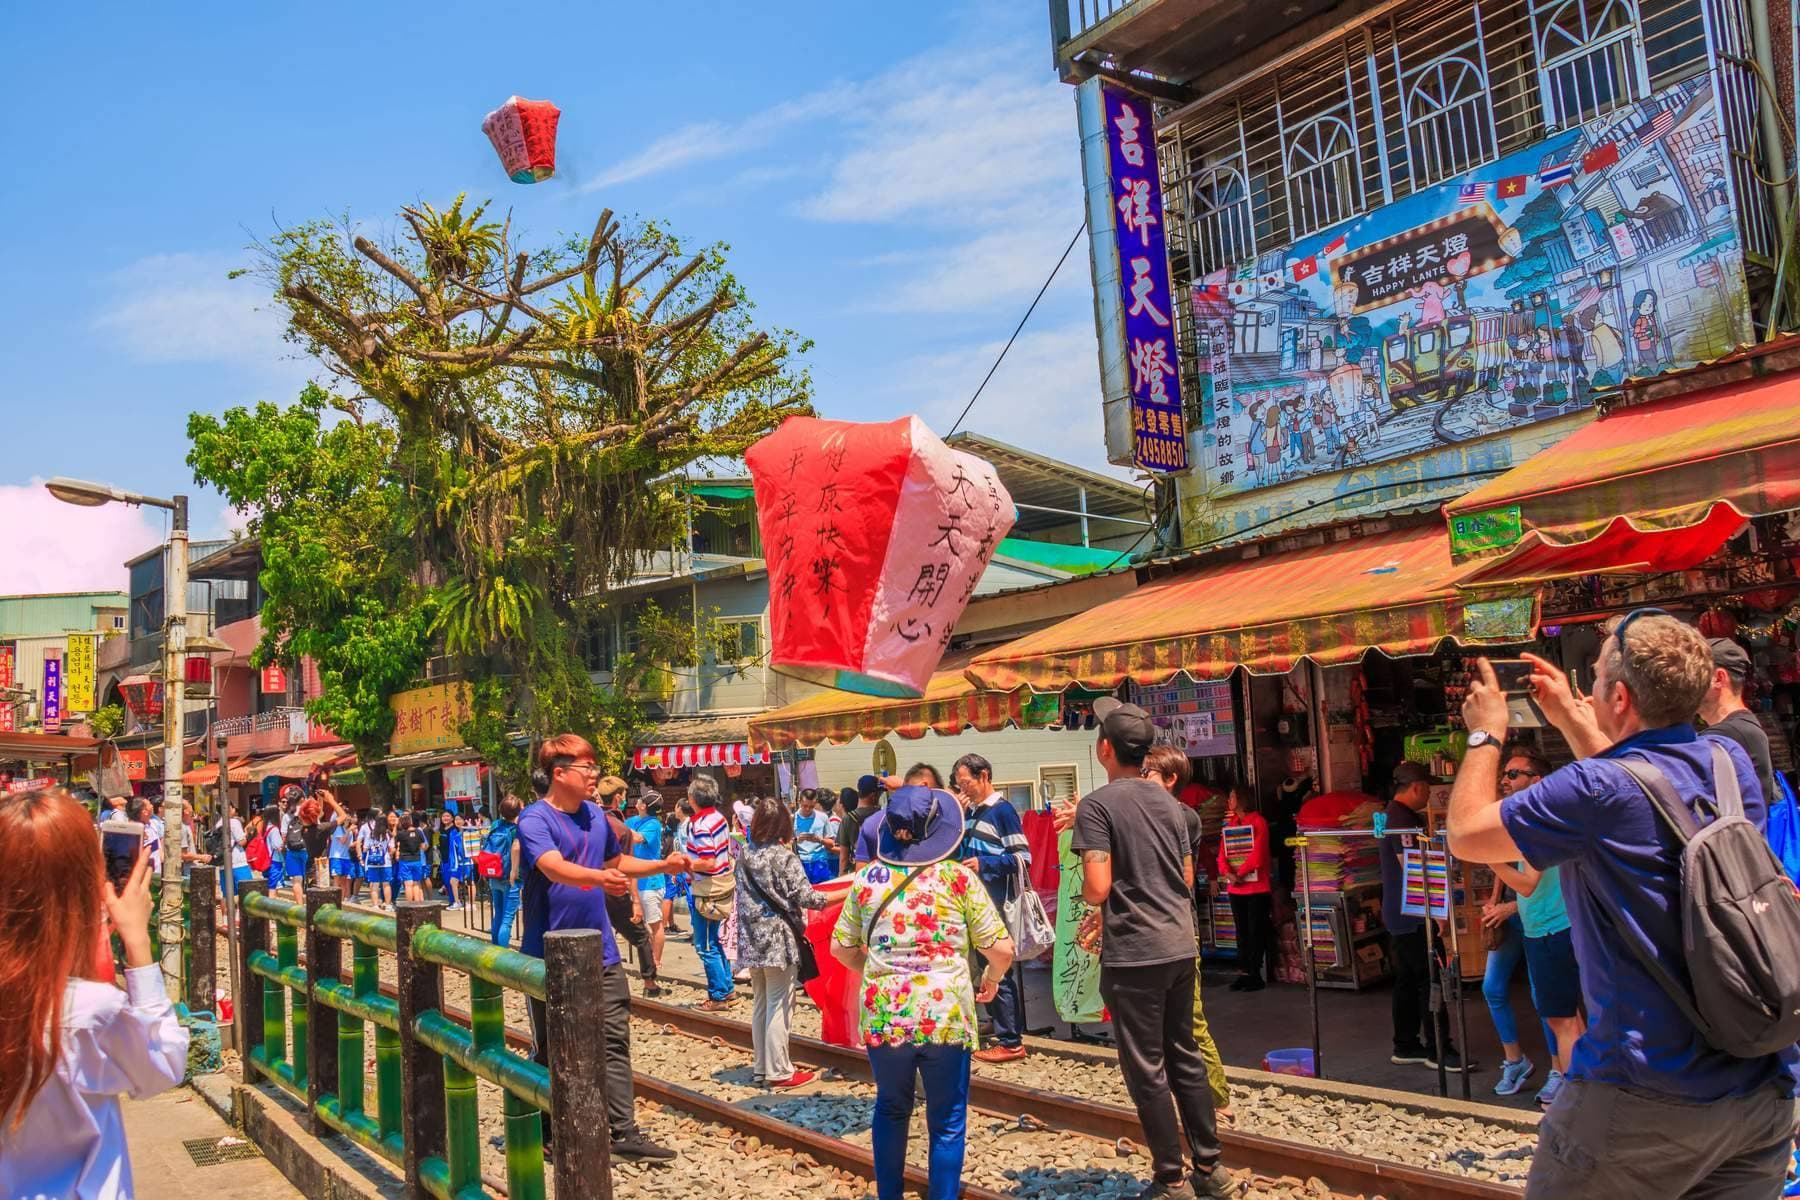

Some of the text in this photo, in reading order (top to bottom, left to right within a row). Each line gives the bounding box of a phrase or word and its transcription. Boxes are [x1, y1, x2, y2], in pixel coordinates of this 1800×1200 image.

[1114, 104, 1174, 403] 吉祥天燈
[1361, 232, 1469, 287] 吉祥天燈
[1372, 279, 1406, 297] HAPPY
[1134, 406, 1182, 437] 批發零售
[1136, 436, 1184, 467] 24958850
[890, 464, 974, 641] 天天開心
